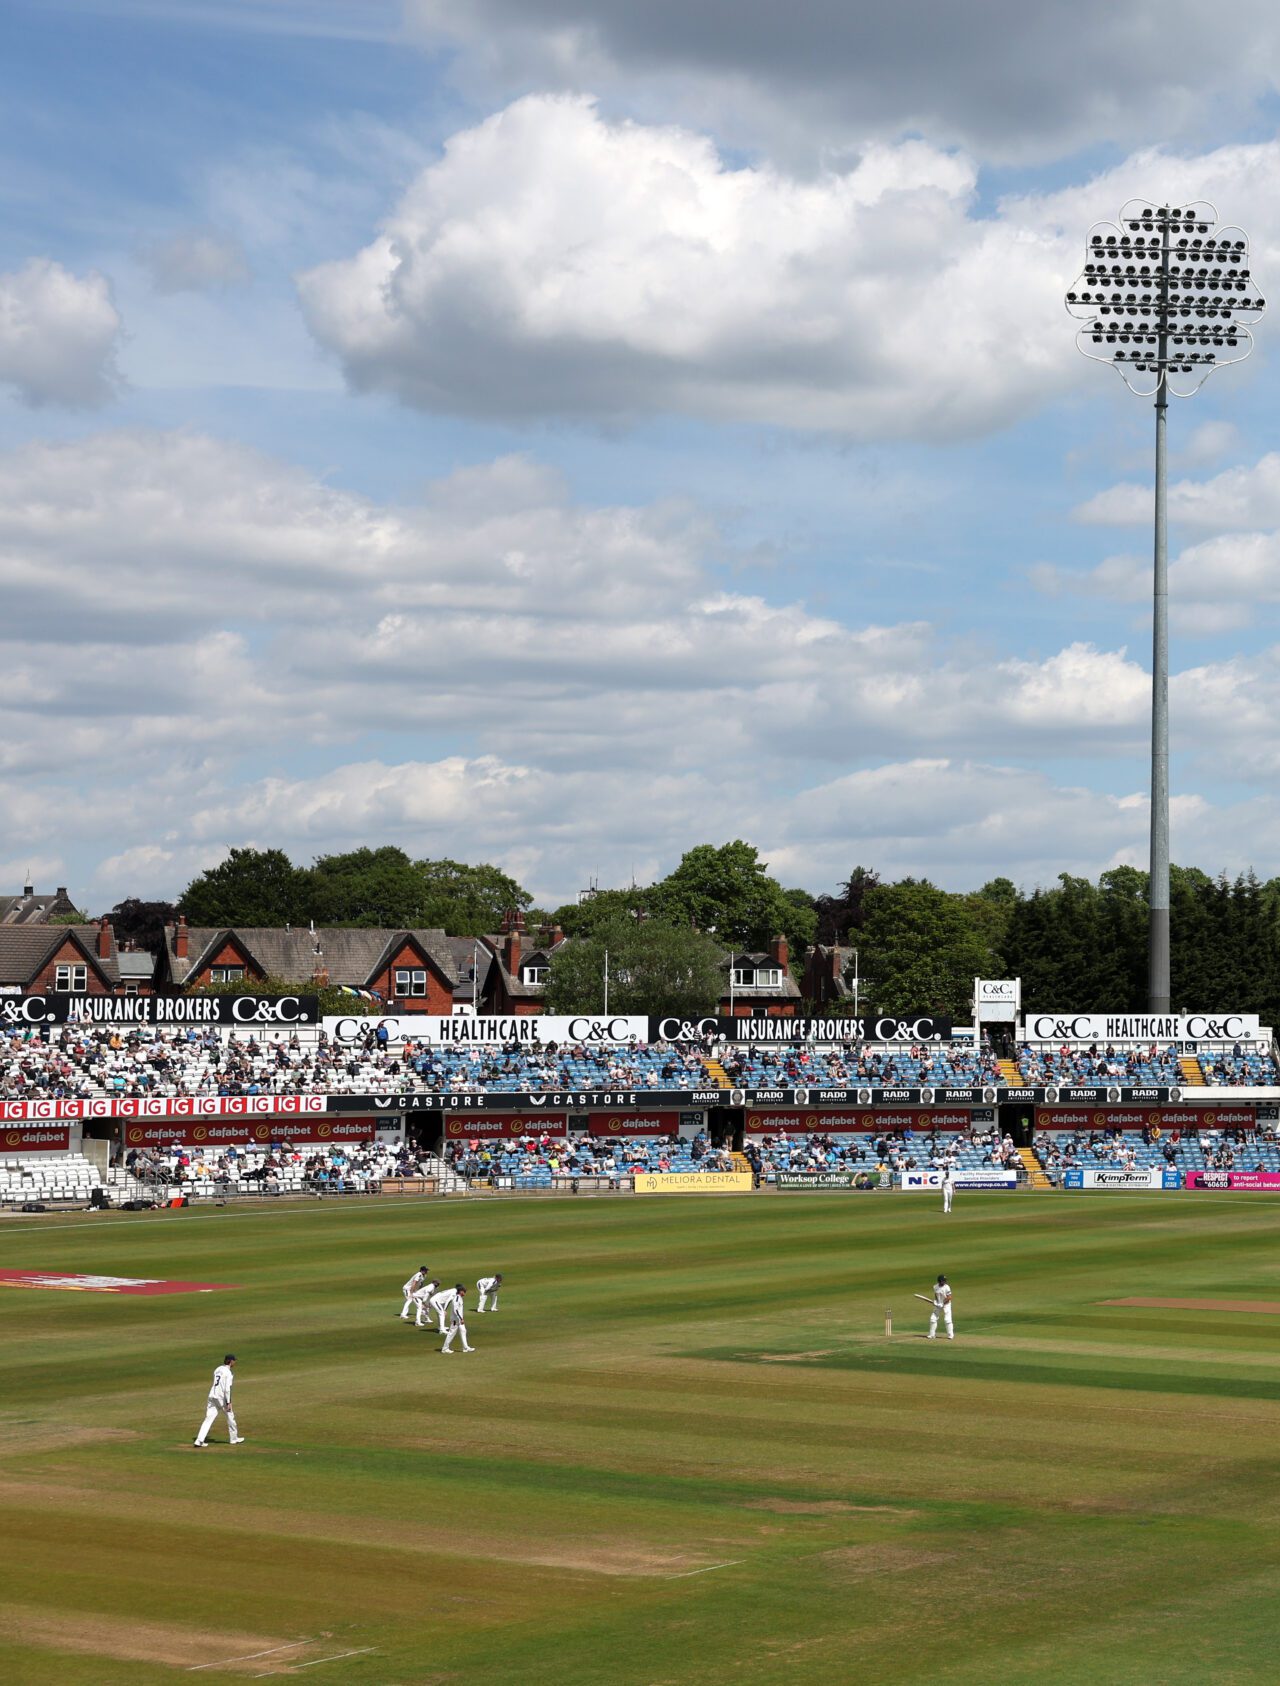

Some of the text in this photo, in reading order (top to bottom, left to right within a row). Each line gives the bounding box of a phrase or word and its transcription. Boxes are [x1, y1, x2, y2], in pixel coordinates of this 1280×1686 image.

[69, 998, 220, 1021] INSURANCE BROKERS
[440, 1019, 538, 1041] HEALTHCARE
[737, 1019, 865, 1040] INSURANCE BROKERS
[1106, 1018, 1179, 1038] HEALTHCARE
[1132, 1089, 1158, 1097] RADO
[225, 1097, 243, 1113] IG
[252, 1097, 269, 1112] IG
[279, 1096, 296, 1112] IG
[305, 1096, 322, 1111] IG
[399, 1095, 484, 1107] CASTORE
[553, 1094, 636, 1105] CASTORE
[3, 1102, 23, 1118] IG
[820, 1116, 856, 1125] dafabet
[875, 1115, 912, 1125] dafabet
[931, 1115, 968, 1124] dafabet
[1052, 1114, 1088, 1123] dafabet
[1107, 1114, 1143, 1123] dafabet
[1162, 1113, 1198, 1122] dafabet
[1217, 1113, 1253, 1122] dafabet
[22, 1132, 65, 1143] dafabet
[208, 1127, 249, 1138] dafabet
[661, 1175, 740, 1184] MELIORA DENTAL
[780, 1173, 849, 1184] Worksop College
[1096, 1173, 1148, 1183] KrimpTerm
[1203, 1173, 1228, 1182] RESPECT
[214, 1375, 221, 1387] 3
